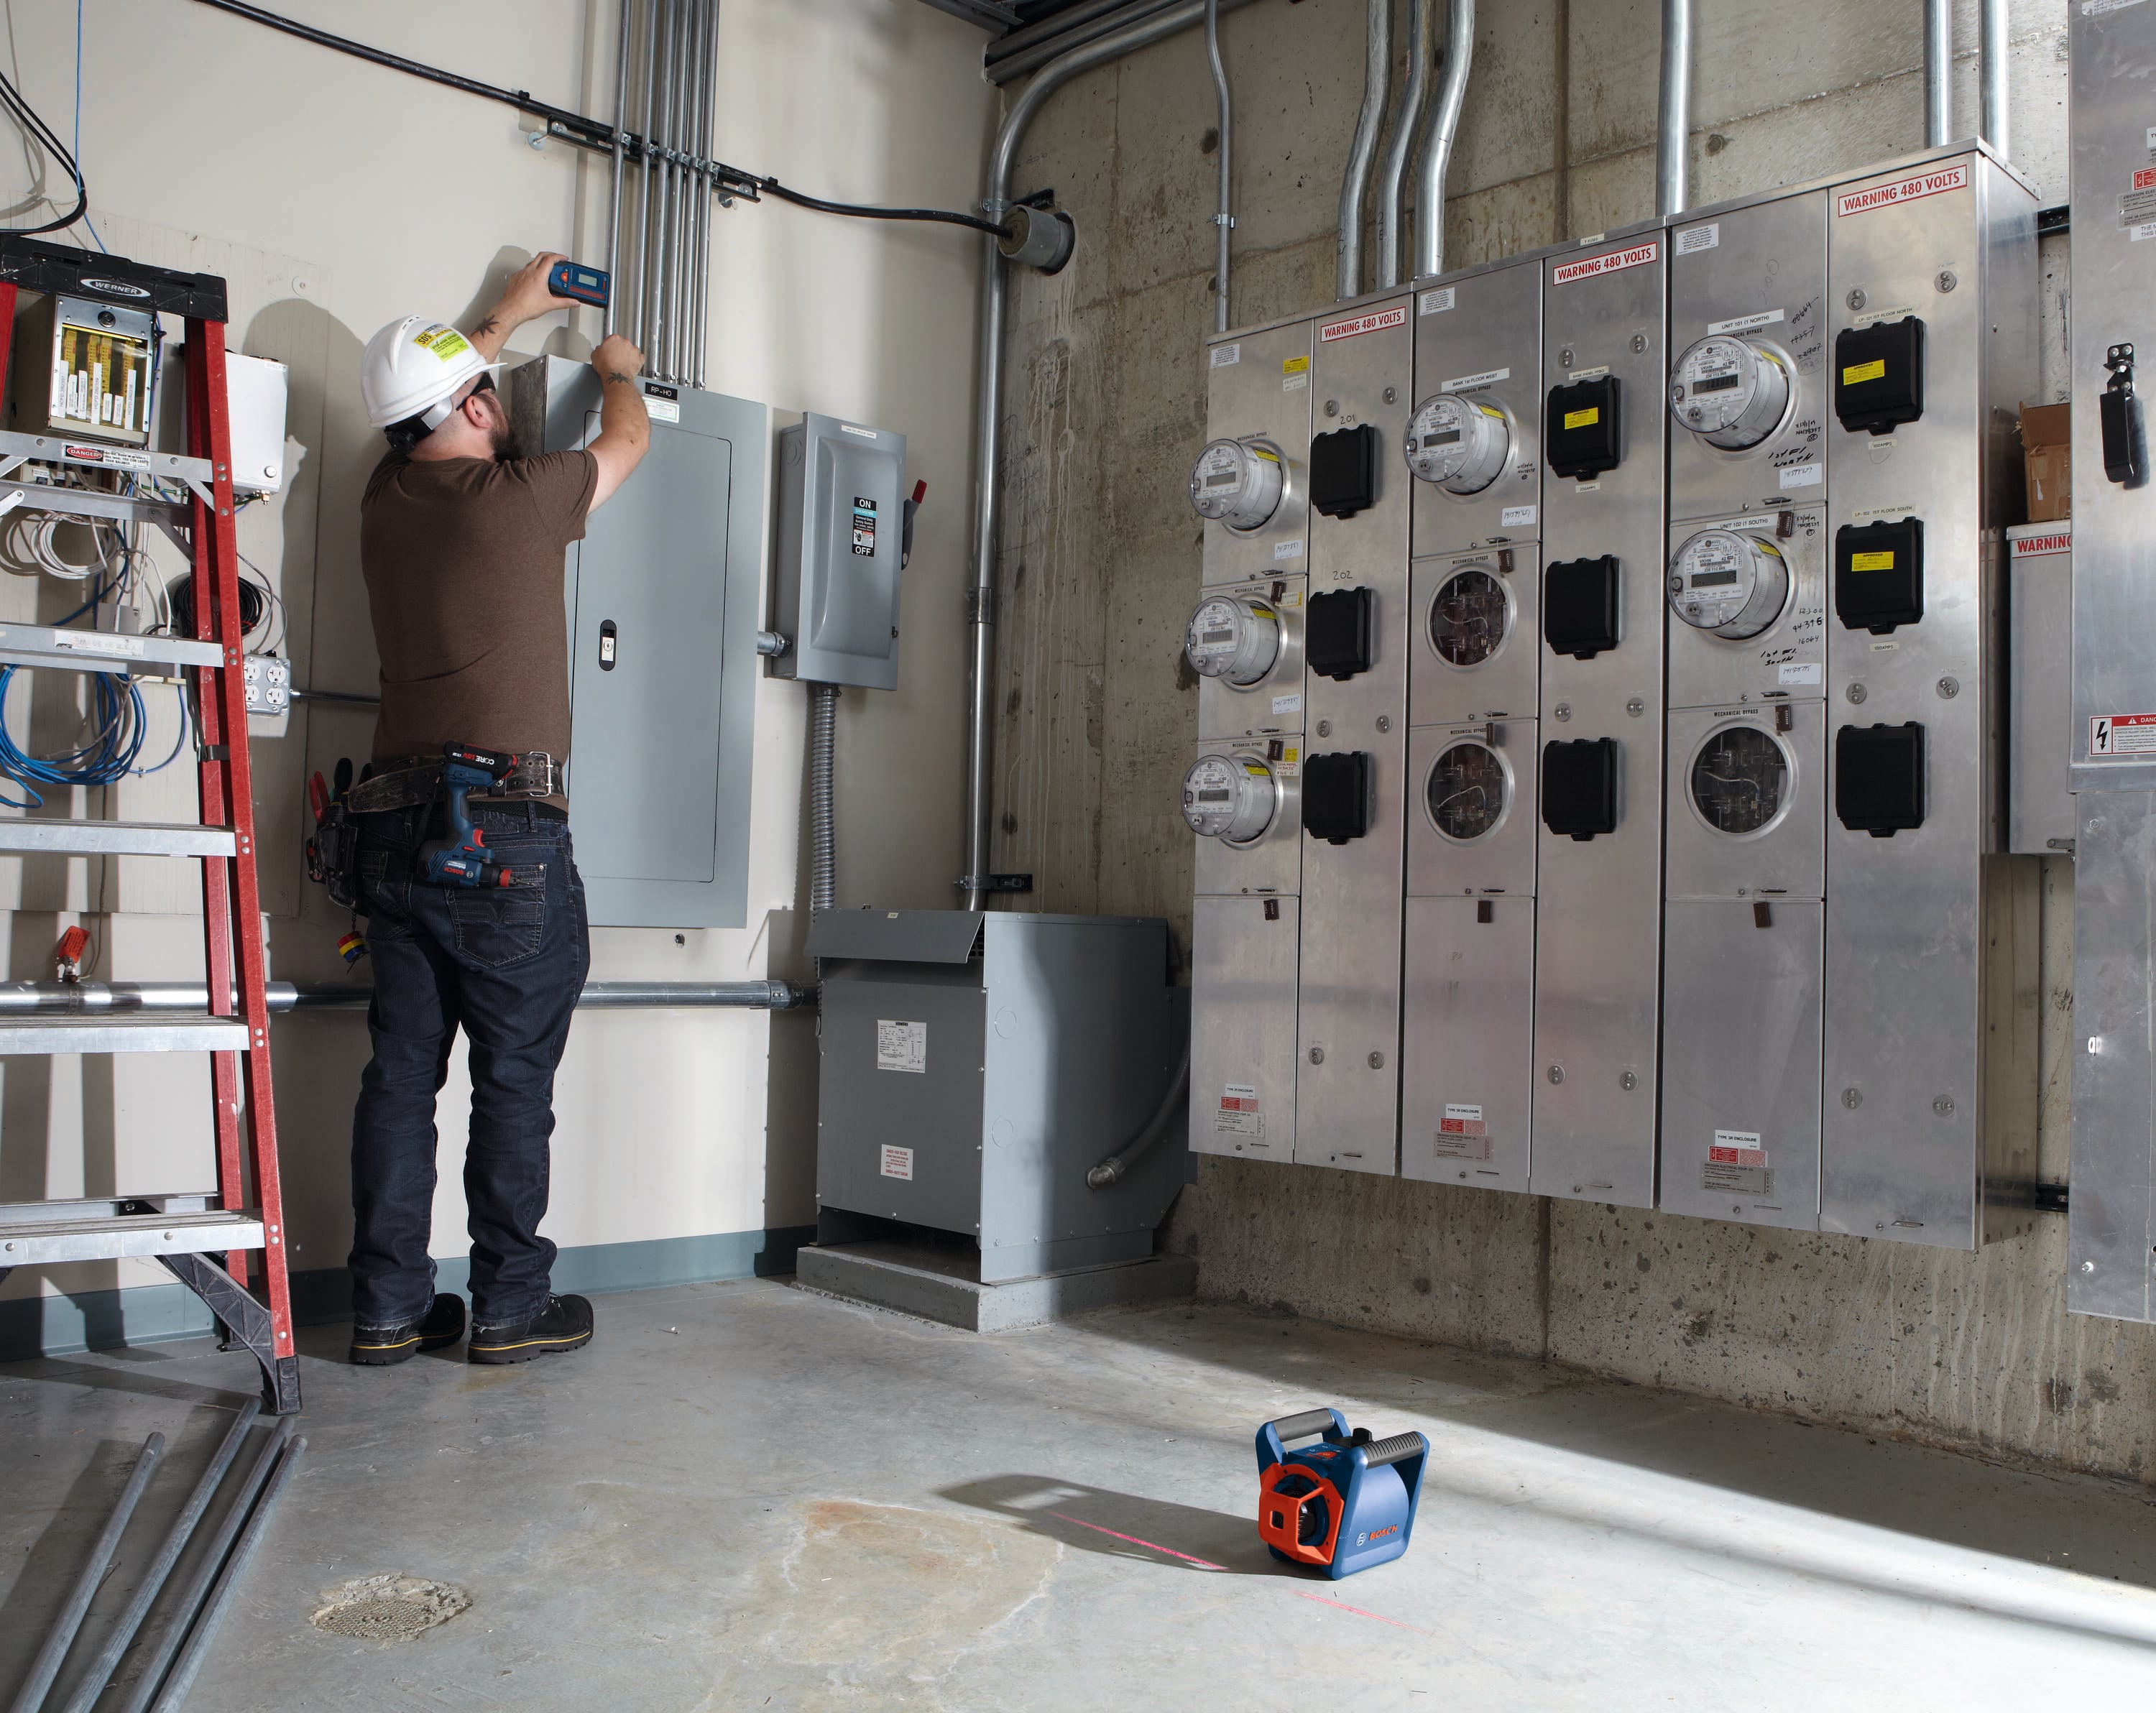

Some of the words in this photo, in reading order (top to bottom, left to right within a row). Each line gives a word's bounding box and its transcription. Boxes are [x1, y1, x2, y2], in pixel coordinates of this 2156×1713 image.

[1844, 188, 1897, 211] WARNING
[1901, 181, 1922, 196] 480
[1925, 171, 1960, 190] VOLTS
[1558, 261, 1601, 280] WARNING
[1603, 256, 1621, 269] 480
[1623, 248, 1651, 264] VOLTS
[95, 282, 138, 295] WERNER
[1325, 321, 1360, 338] WARNING
[1362, 317, 1376, 329] 480
[1378, 311, 1401, 325] VOLTS
[418, 333, 432, 344] SDS
[1455, 387, 1477, 395] MECHANICAL
[1340, 414, 1355, 425] 201
[70, 449, 99, 458] DANGER
[859, 499, 871, 509] ON
[855, 546, 871, 555] OFF
[1333, 570, 1353, 581] 202
[443, 867, 464, 876] BOSCH
[1369, 1523, 1398, 1541] BOSCH
